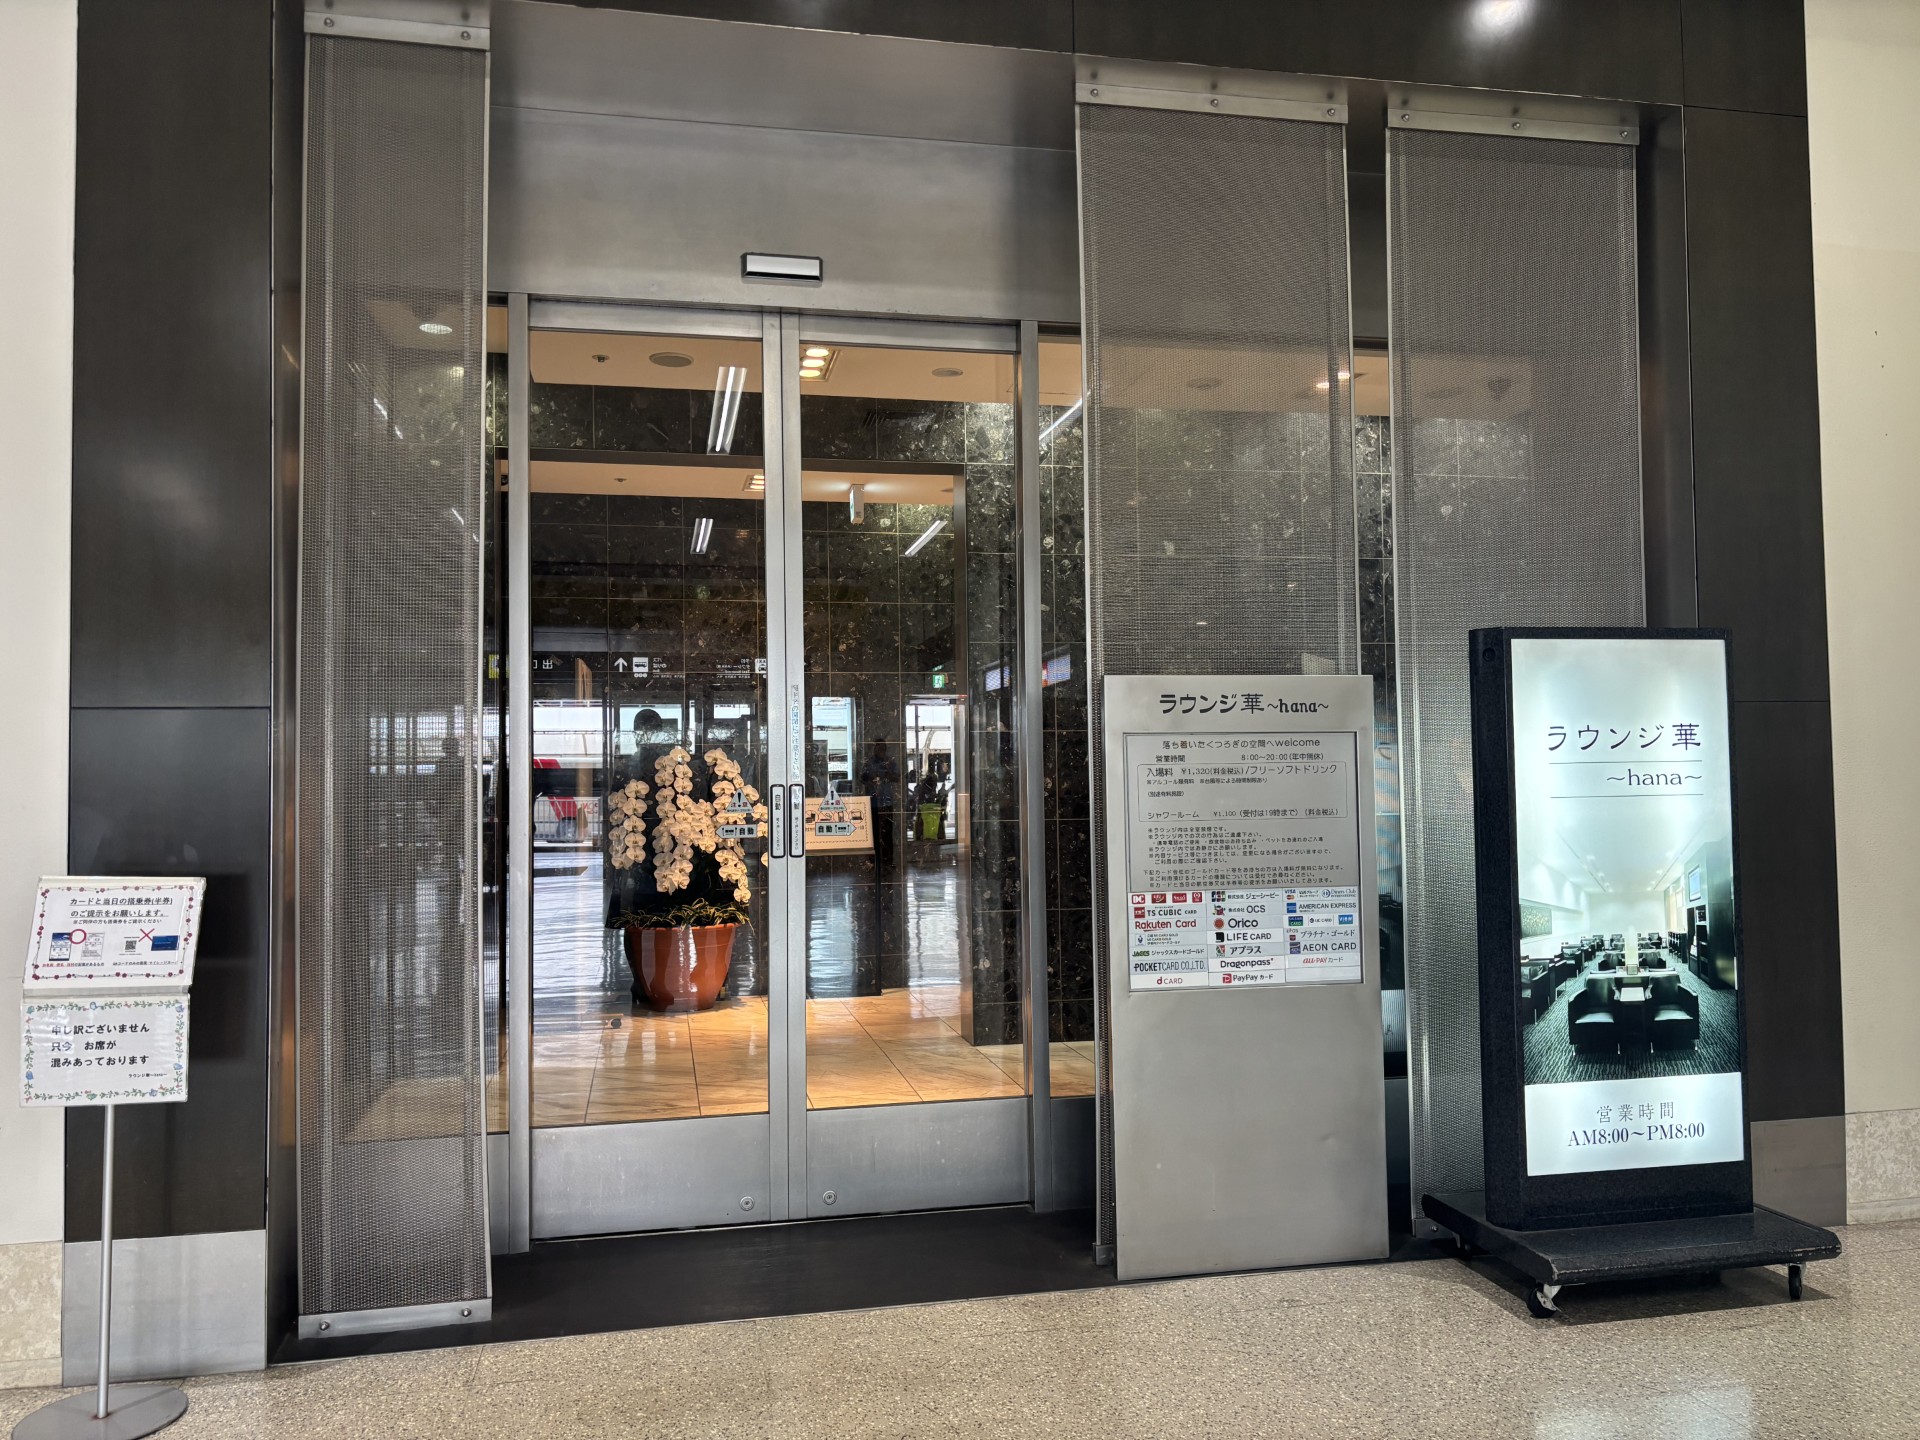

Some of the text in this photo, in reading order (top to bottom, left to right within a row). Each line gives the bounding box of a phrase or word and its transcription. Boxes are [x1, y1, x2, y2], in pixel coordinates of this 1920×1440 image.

[1548, 723, 1701, 751] ラウンジ華
[1155, 754, 1186, 763] 営業時間
[1146, 767, 1173, 777] 入場料
[1148, 811, 1200, 820] シャワールーム
[739, 827, 754, 835] 自動
[818, 824, 833, 834] 自動
[1133, 894, 1145, 903] DC
[1245, 892, 1280, 900] ジェーシービー
[70, 909, 164, 917] のご提示をお願いします。
[1147, 909, 1156, 917] TS
[1246, 904, 1266, 914] OCS
[1135, 919, 1197, 929] Rakuten Card
[1227, 917, 1259, 928] Orico
[1226, 932, 1272, 941] LIFE CARD
[1300, 929, 1355, 938] プラチナ・ゴールド
[1229, 945, 1262, 955] アプラス
[1302, 943, 1328, 951] AEON
[1331, 942, 1357, 951] CARD
[1220, 958, 1271, 968] Dragonpass
[51, 1022, 150, 1035] 申し訳ございません
[51, 1040, 117, 1052] 只今 お席が
[50, 1055, 149, 1068] 混みあっております
[1596, 1101, 1674, 1123] 営業時間
[1567, 1122, 1705, 1146] AM8:00～PM8:00
